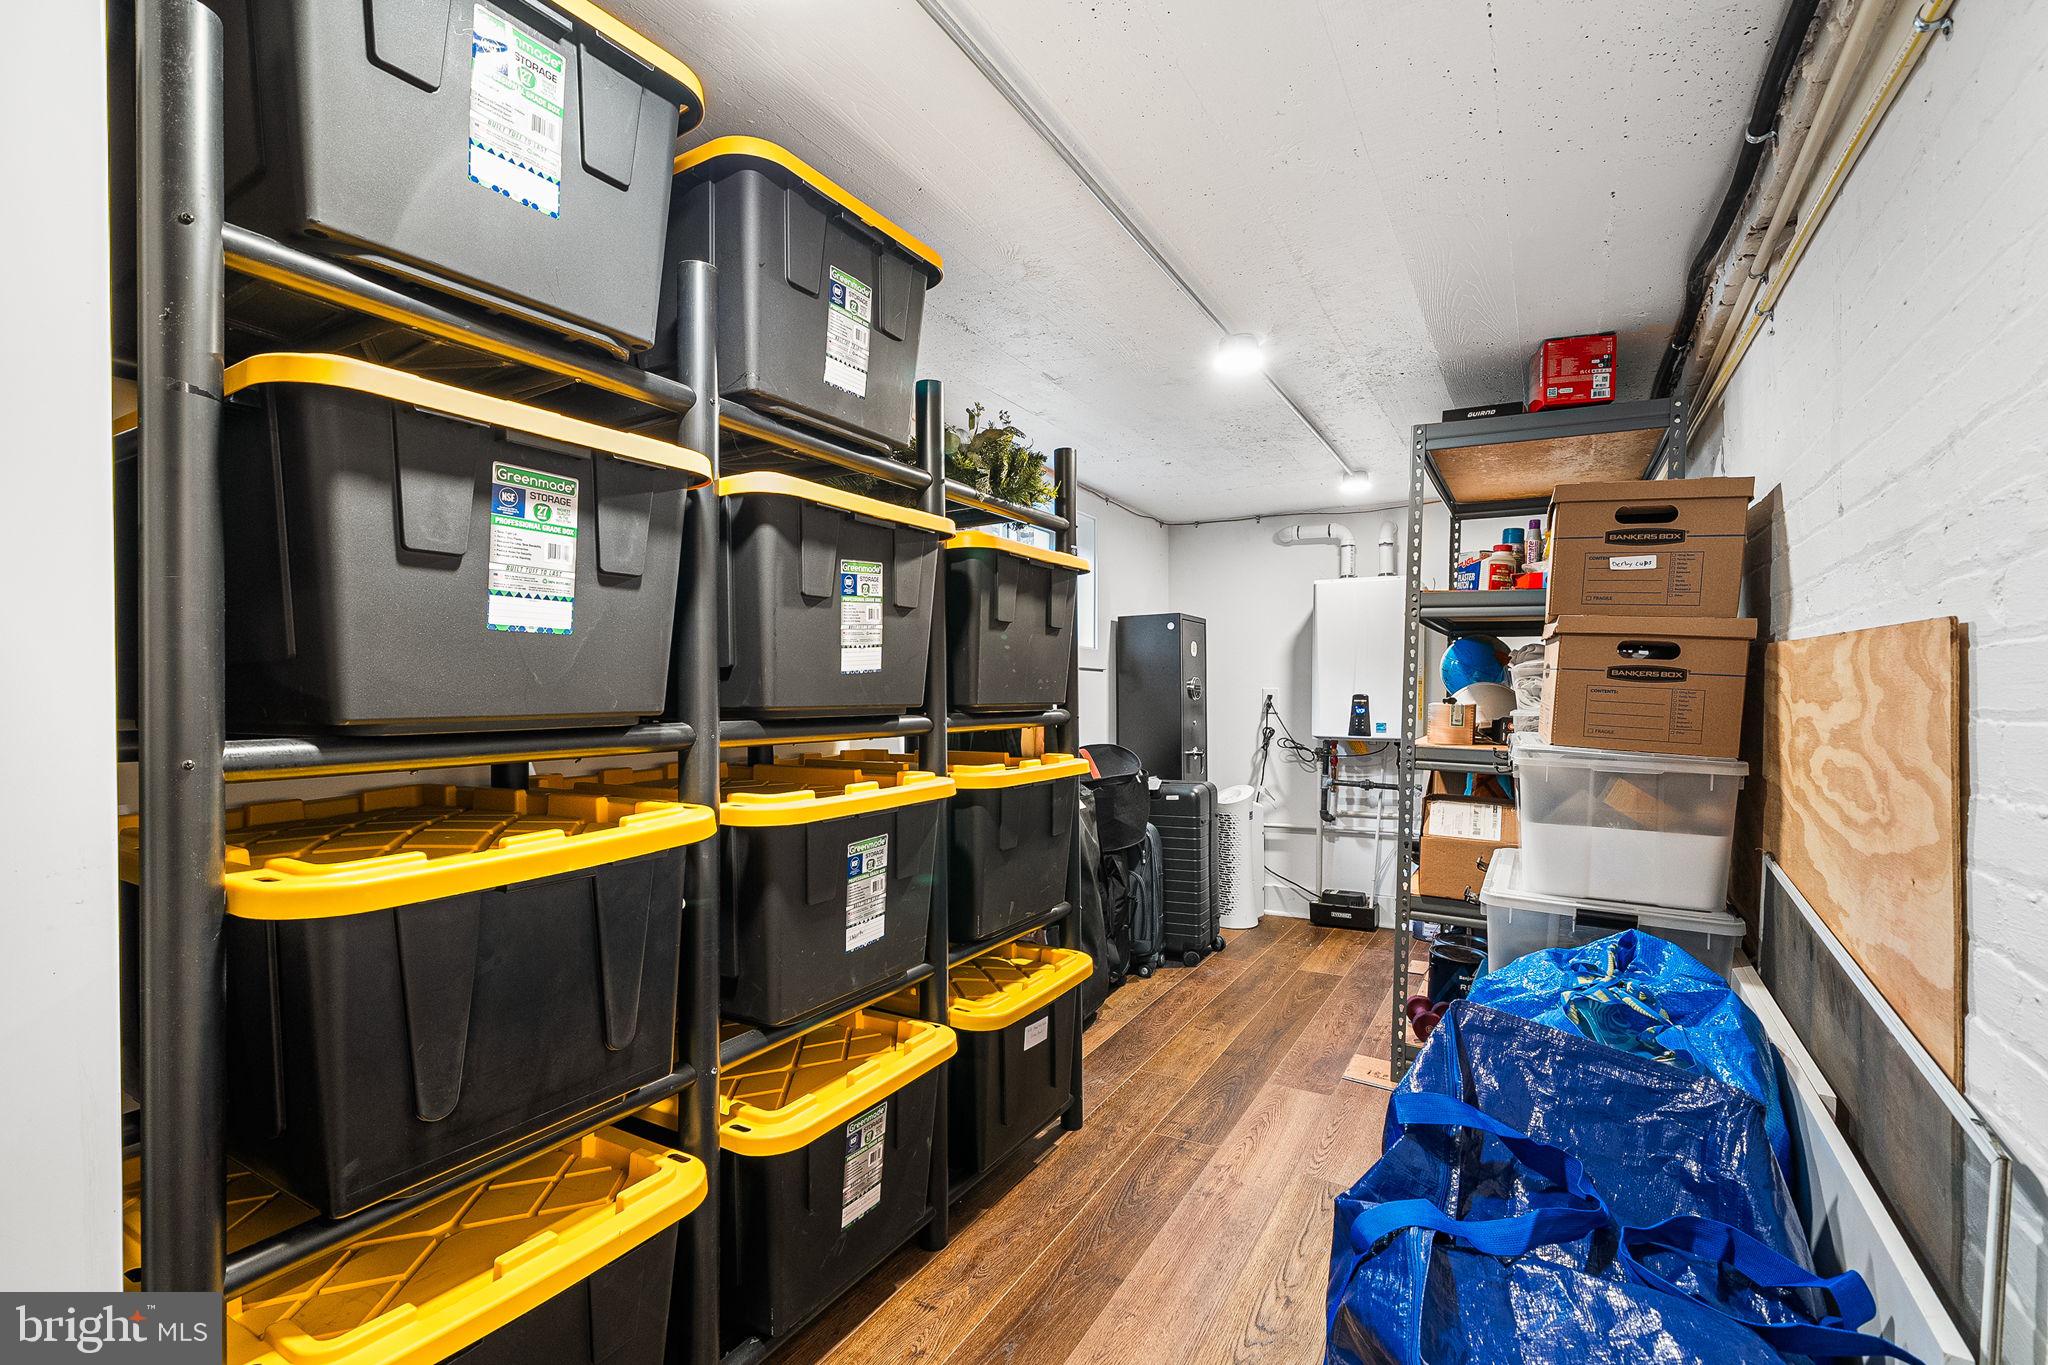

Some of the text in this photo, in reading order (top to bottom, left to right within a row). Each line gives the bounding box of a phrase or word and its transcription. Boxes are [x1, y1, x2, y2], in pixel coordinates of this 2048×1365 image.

[515, 37, 561, 67] nmade
[514, 51, 557, 84] STORAGE
[831, 269, 870, 297] Greenmade
[497, 468, 573, 493] Greenmade
[530, 491, 572, 507] STORAGE
[537, 504, 548, 515] 27
[495, 517, 575, 536] PROFESSIONAL GRADE BOX
[1609, 533, 1658, 541] BANKERS
[506, 564, 523, 573] BUILT
[525, 566, 539, 574] TUFF
[540, 568, 548, 576] TO
[843, 562, 880, 573] Greenmade
[1611, 670, 1659, 678] BANKERS
[849, 838, 886, 854] Greenmade
[849, 1107, 884, 1132] Greenmade
